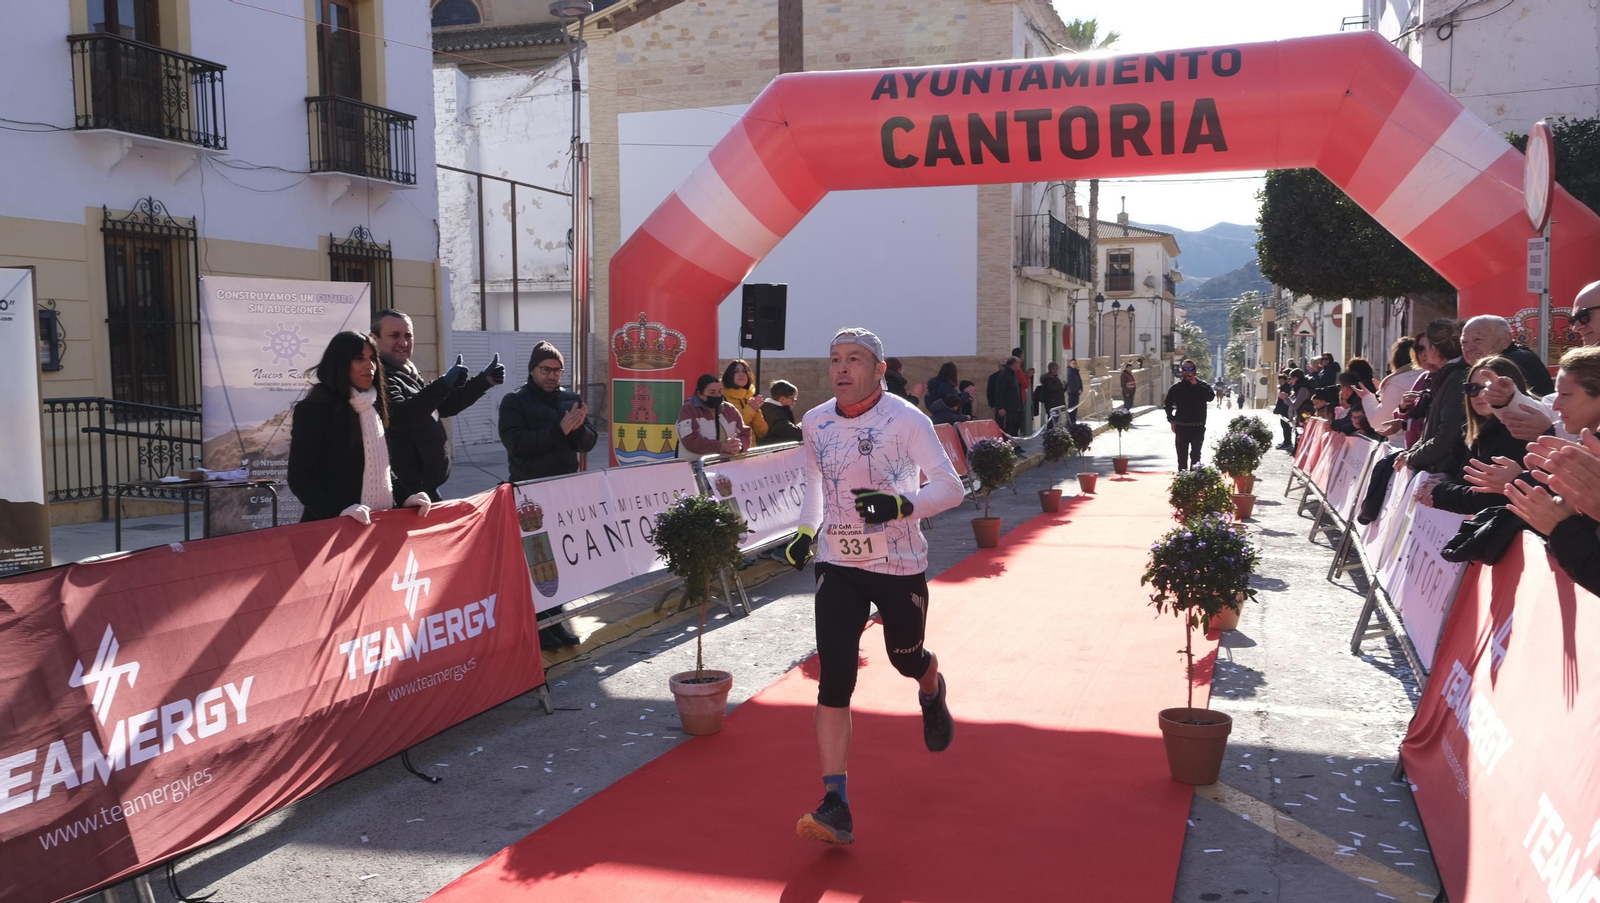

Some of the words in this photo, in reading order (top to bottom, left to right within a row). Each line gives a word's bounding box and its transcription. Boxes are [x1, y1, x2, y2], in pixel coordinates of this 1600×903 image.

[871, 48, 1242, 100] AYUNTAMIENTO
[880, 97, 1229, 169] CANTORIA
[216, 289, 297, 303] CONSTRUYAMOS
[300, 293, 314, 303] UN
[316, 293, 354, 304] FUTURO
[248, 303, 265, 314] SIN
[267, 304, 325, 316] ADICCIONES
[252, 368, 283, 380] Nuevo
[740, 467, 806, 494] AYUNTAMIENTO
[839, 536, 873, 556] 331
[339, 593, 497, 681] TEAMERGY
[1441, 658, 1514, 777] TEAMERGY
[38, 766, 213, 851] www.teamergy.es
